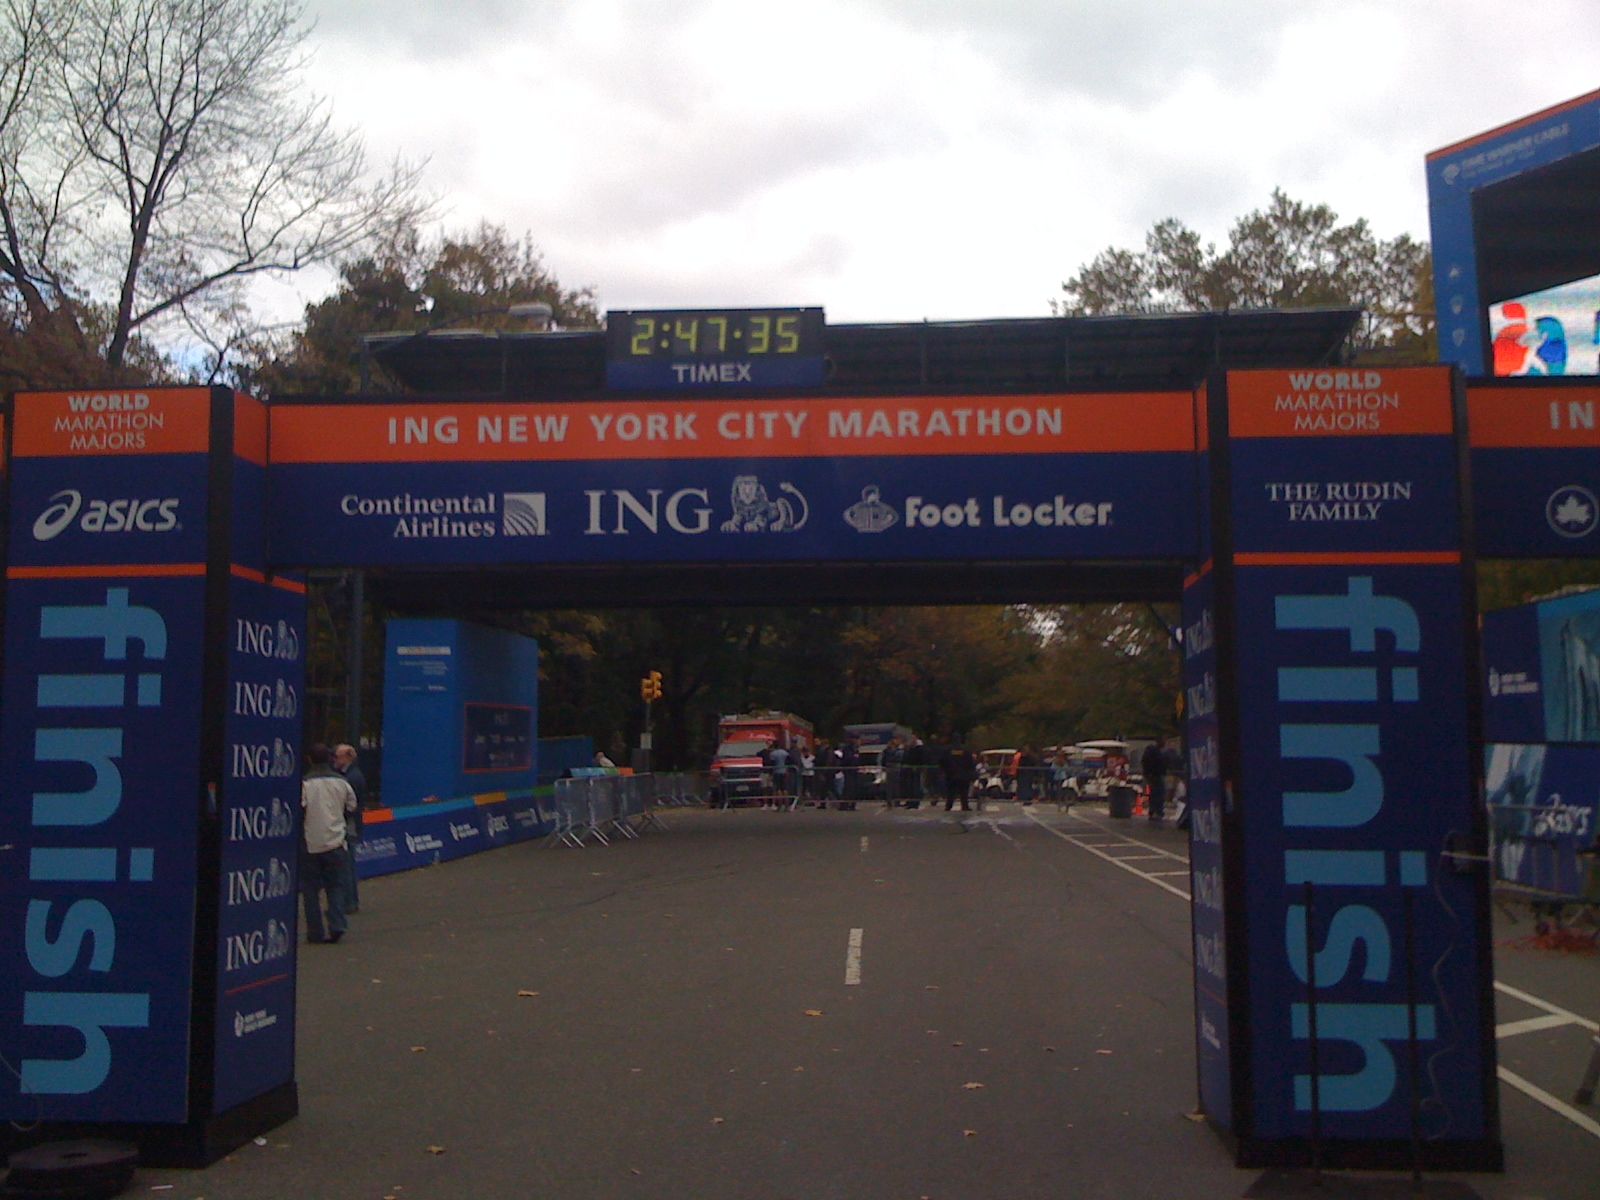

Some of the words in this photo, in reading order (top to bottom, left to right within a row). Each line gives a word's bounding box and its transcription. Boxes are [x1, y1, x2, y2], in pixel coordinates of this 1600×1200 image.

[672, 362, 752, 383] TIMEX
[1288, 371, 1382, 391] WORLD
[67, 393, 150, 412] WORLD
[1274, 391, 1400, 412] MARATHON
[54, 411, 164, 432] MARATHON
[388, 416, 459, 444] ING
[477, 414, 569, 443] NEW
[589, 413, 697, 441] YORK
[717, 410, 808, 440] CITY
[828, 407, 1062, 438] MARATHON
[1294, 411, 1380, 431] MAJORS
[69, 431, 146, 450] MAJORS
[341, 493, 496, 517] Continental
[1265, 483, 1320, 501] THE
[1327, 481, 1412, 501] RUDIN
[583, 487, 713, 535] ING
[905, 496, 981, 527] Foot
[993, 495, 1113, 527] Locker
[1288, 502, 1382, 522] FAMILY
[393, 516, 496, 539] Airlines
[236, 618, 273, 658] ING
[234, 681, 272, 718] ING
[232, 743, 269, 778] ING
[230, 806, 267, 841] ING
[20, 587, 168, 1094] finish
[1275, 576, 1436, 1111] finish
[227, 868, 265, 906] ING
[225, 930, 263, 971] ING
